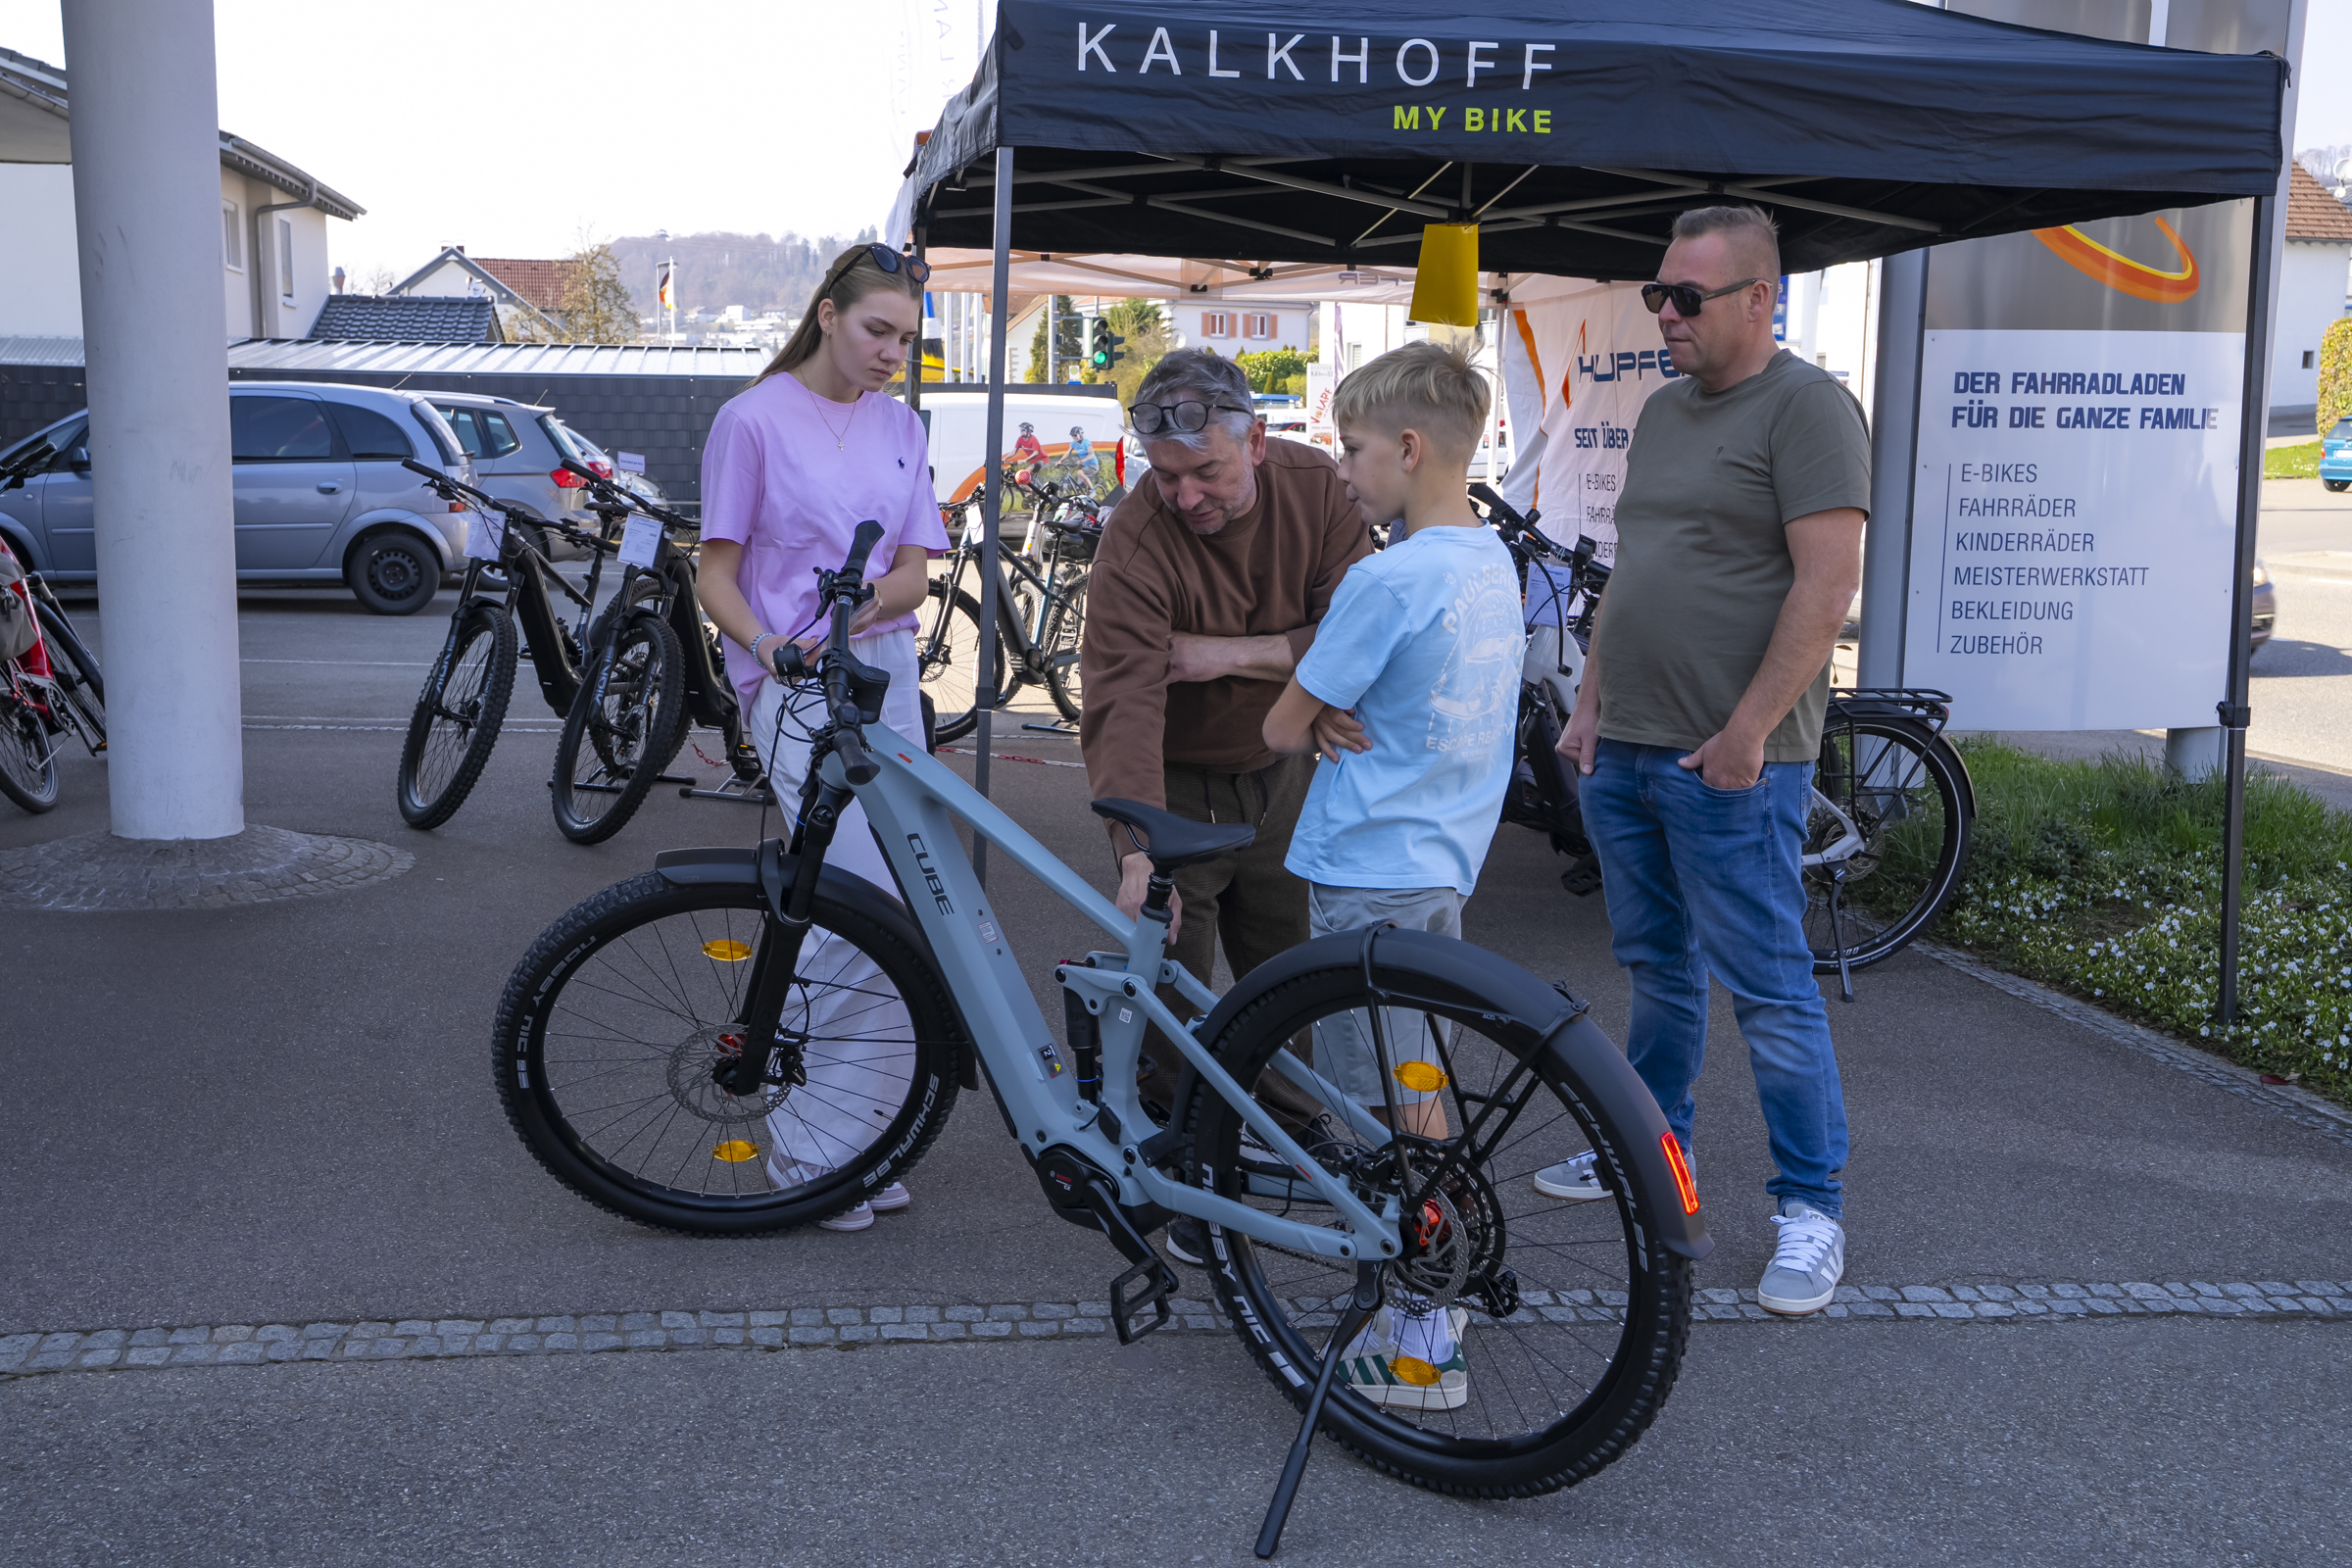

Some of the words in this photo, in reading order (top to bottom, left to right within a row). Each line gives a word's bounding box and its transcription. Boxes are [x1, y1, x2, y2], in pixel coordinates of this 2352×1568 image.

[1077, 22, 1556, 90] KALKHOFF
[1393, 105, 1447, 131] MY
[1464, 107, 1552, 134] BIKE
[1578, 347, 1692, 384] HUPFE
[1953, 371, 2000, 394] DER
[2011, 371, 2186, 395] FAHRRADLADEN
[1951, 399, 1998, 428] FÜR
[2008, 407, 2046, 428] DIE
[2056, 407, 2132, 429] GANZE
[2139, 408, 2220, 429] FAMILIE
[1574, 427, 1597, 449] SEIT
[1600, 420, 1629, 450] ÜBER
[1586, 472, 1616, 492] E-BIKES
[1960, 463, 2038, 484] E-BIKES
[1959, 493, 2077, 517] FAHRRÄDER
[1955, 528, 2095, 553] KINDERRÄDER
[1953, 565, 2150, 587] MEISTERWERKSTATT
[1951, 600, 2074, 621] BEKLEIDUNG
[1949, 631, 2043, 656] ZUBEHÖR
[906, 832, 956, 916] CUBE
[862, 1072, 940, 1189] SCHWALBE
[1559, 1081, 1648, 1273] SCHWALBE
